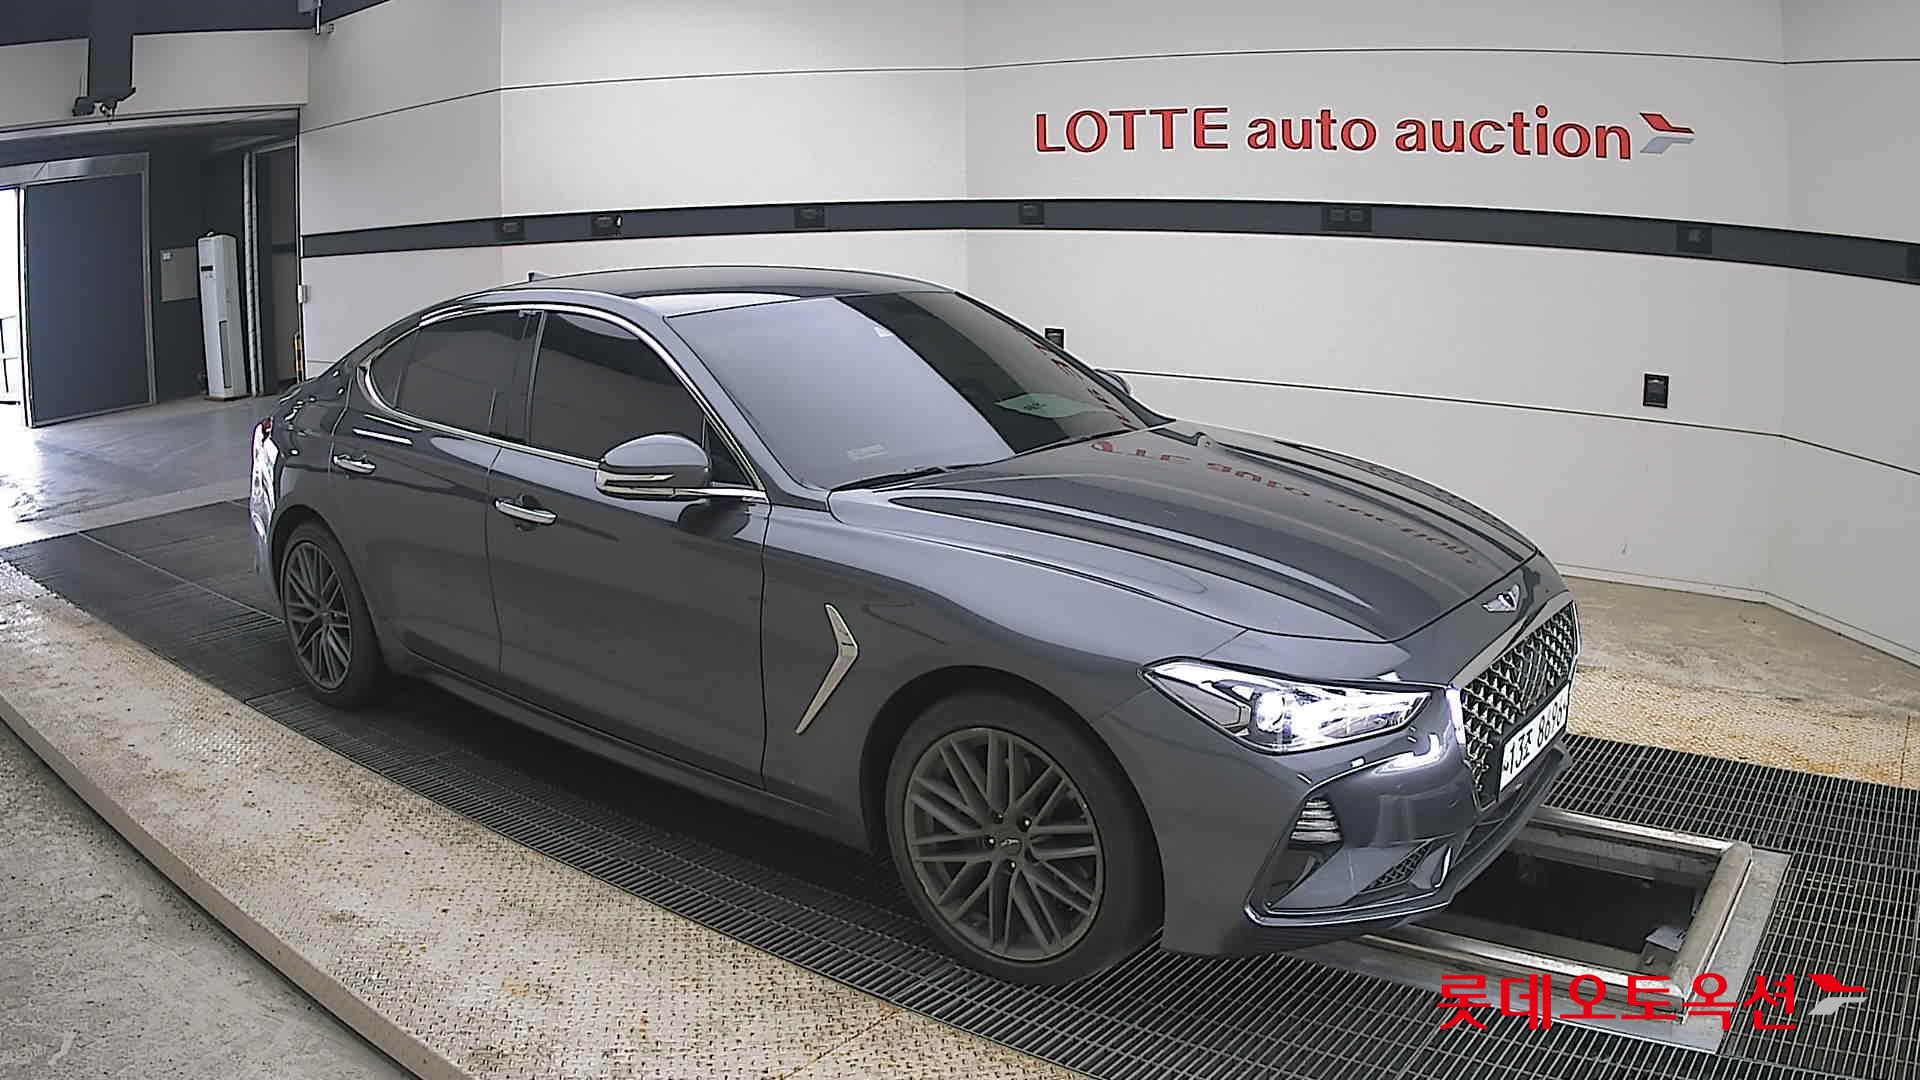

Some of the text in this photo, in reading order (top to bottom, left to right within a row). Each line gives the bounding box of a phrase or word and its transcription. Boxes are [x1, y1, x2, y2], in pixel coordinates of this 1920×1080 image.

[1035, 105, 1633, 160] LOTTE auto auction
